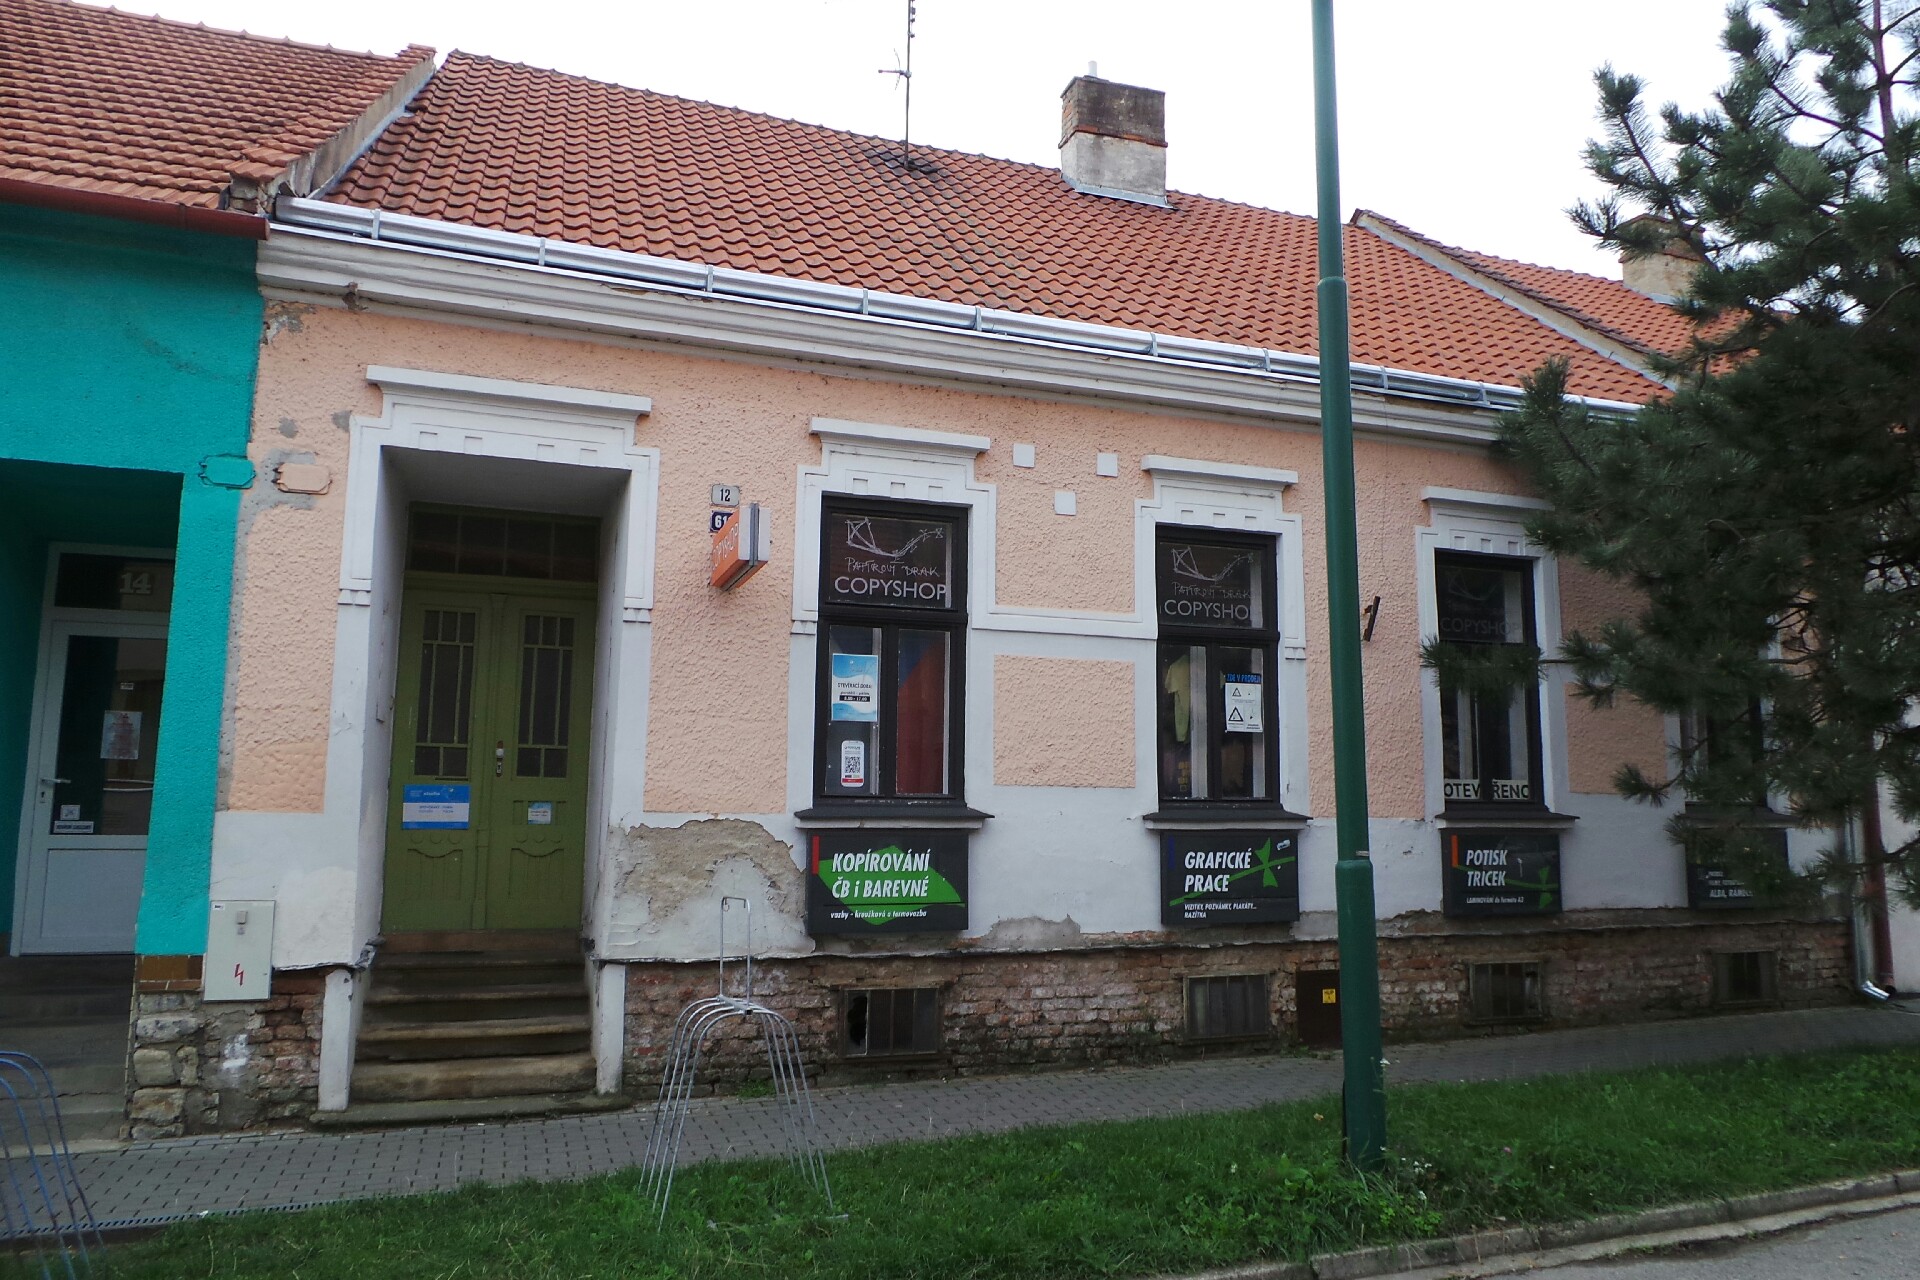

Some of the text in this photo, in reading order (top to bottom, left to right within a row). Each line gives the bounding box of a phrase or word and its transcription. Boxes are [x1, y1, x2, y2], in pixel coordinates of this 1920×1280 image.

[719, 488, 731, 502] 12
[119, 572, 152, 594] 14
[834, 575, 947, 601] COPYSHOP
[1164, 599, 1249, 620] COPYSHO
[832, 848, 931, 873] KOPÍROVÁNÍ
[1184, 847, 1252, 869] GRAFICKÉ
[1465, 849, 1508, 866] POTISK
[831, 875, 929, 898] ČB i BAREVNÉ
[1184, 874, 1230, 892] PRACE
[830, 910, 849, 920] vazby
